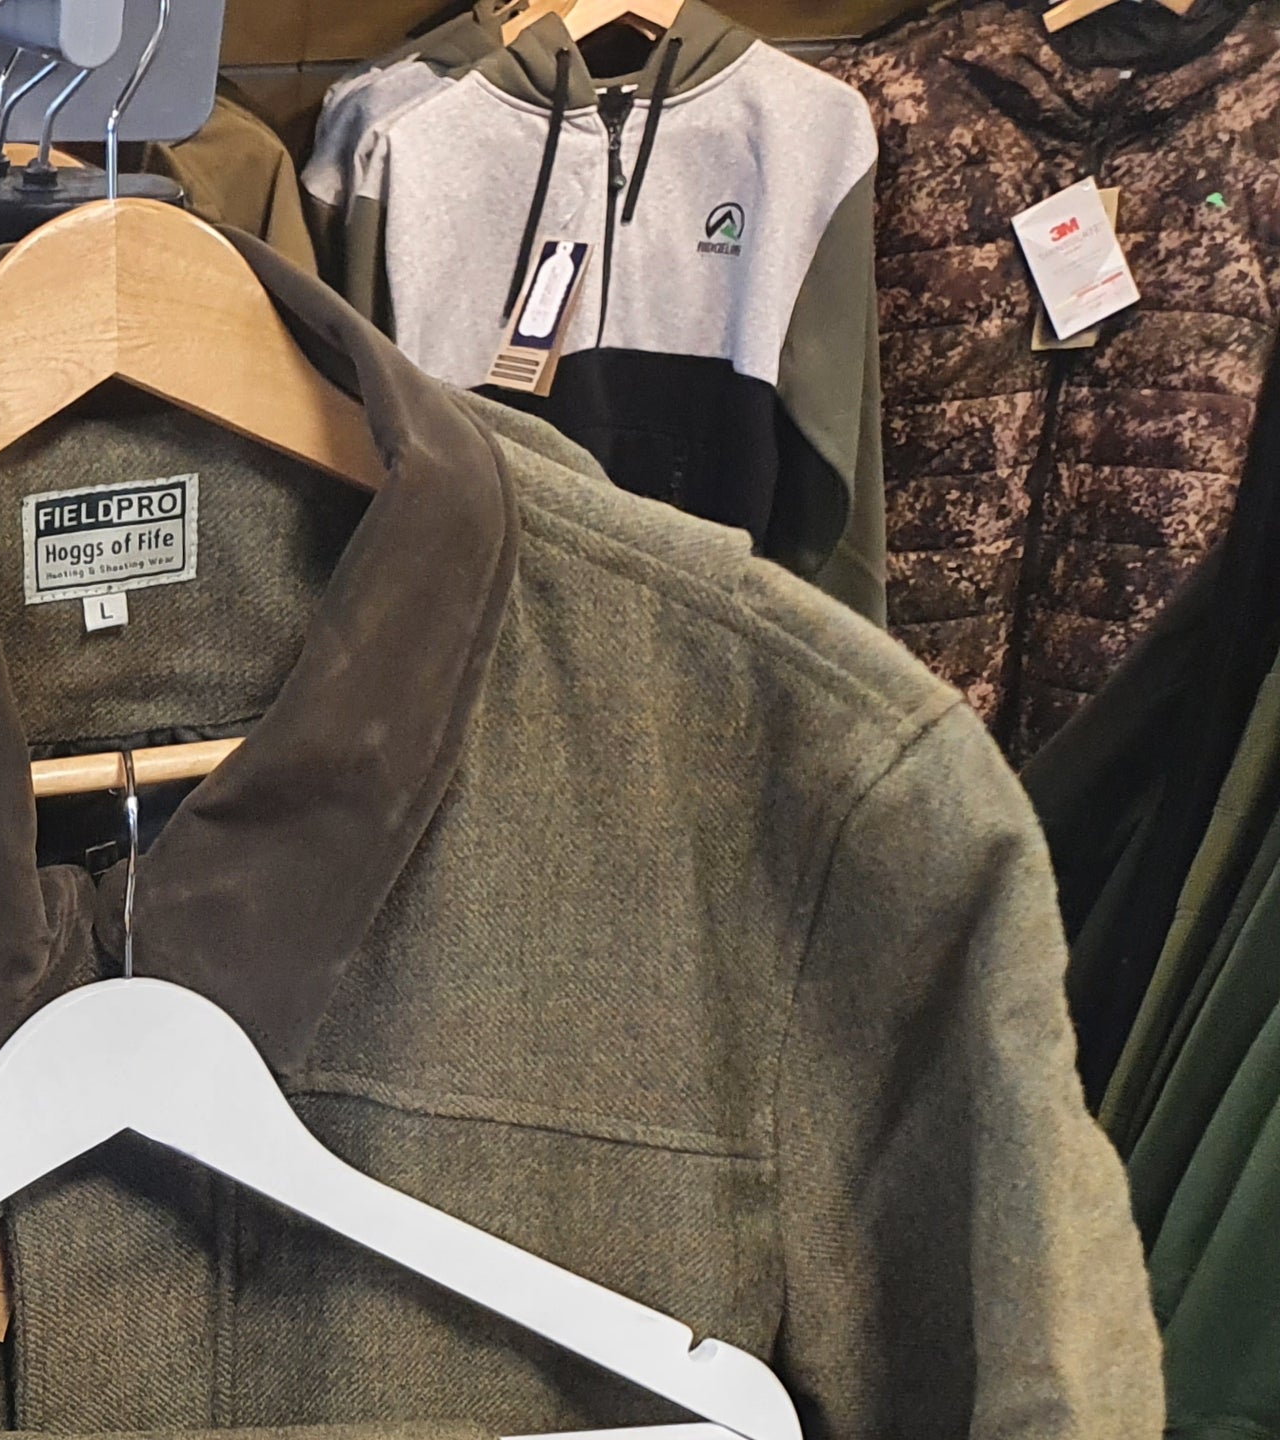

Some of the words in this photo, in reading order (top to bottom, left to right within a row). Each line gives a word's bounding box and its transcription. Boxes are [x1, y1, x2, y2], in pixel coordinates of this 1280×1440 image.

[1049, 217, 1080, 242] 3M
[38, 492, 178, 530] FIELDPRO
[45, 540, 104, 565] Hoggs
[111, 532, 132, 555] of
[138, 528, 174, 551] Fife
[99, 560, 144, 574] Shooting
[149, 556, 174, 566] Wear
[100, 602, 113, 620] L
